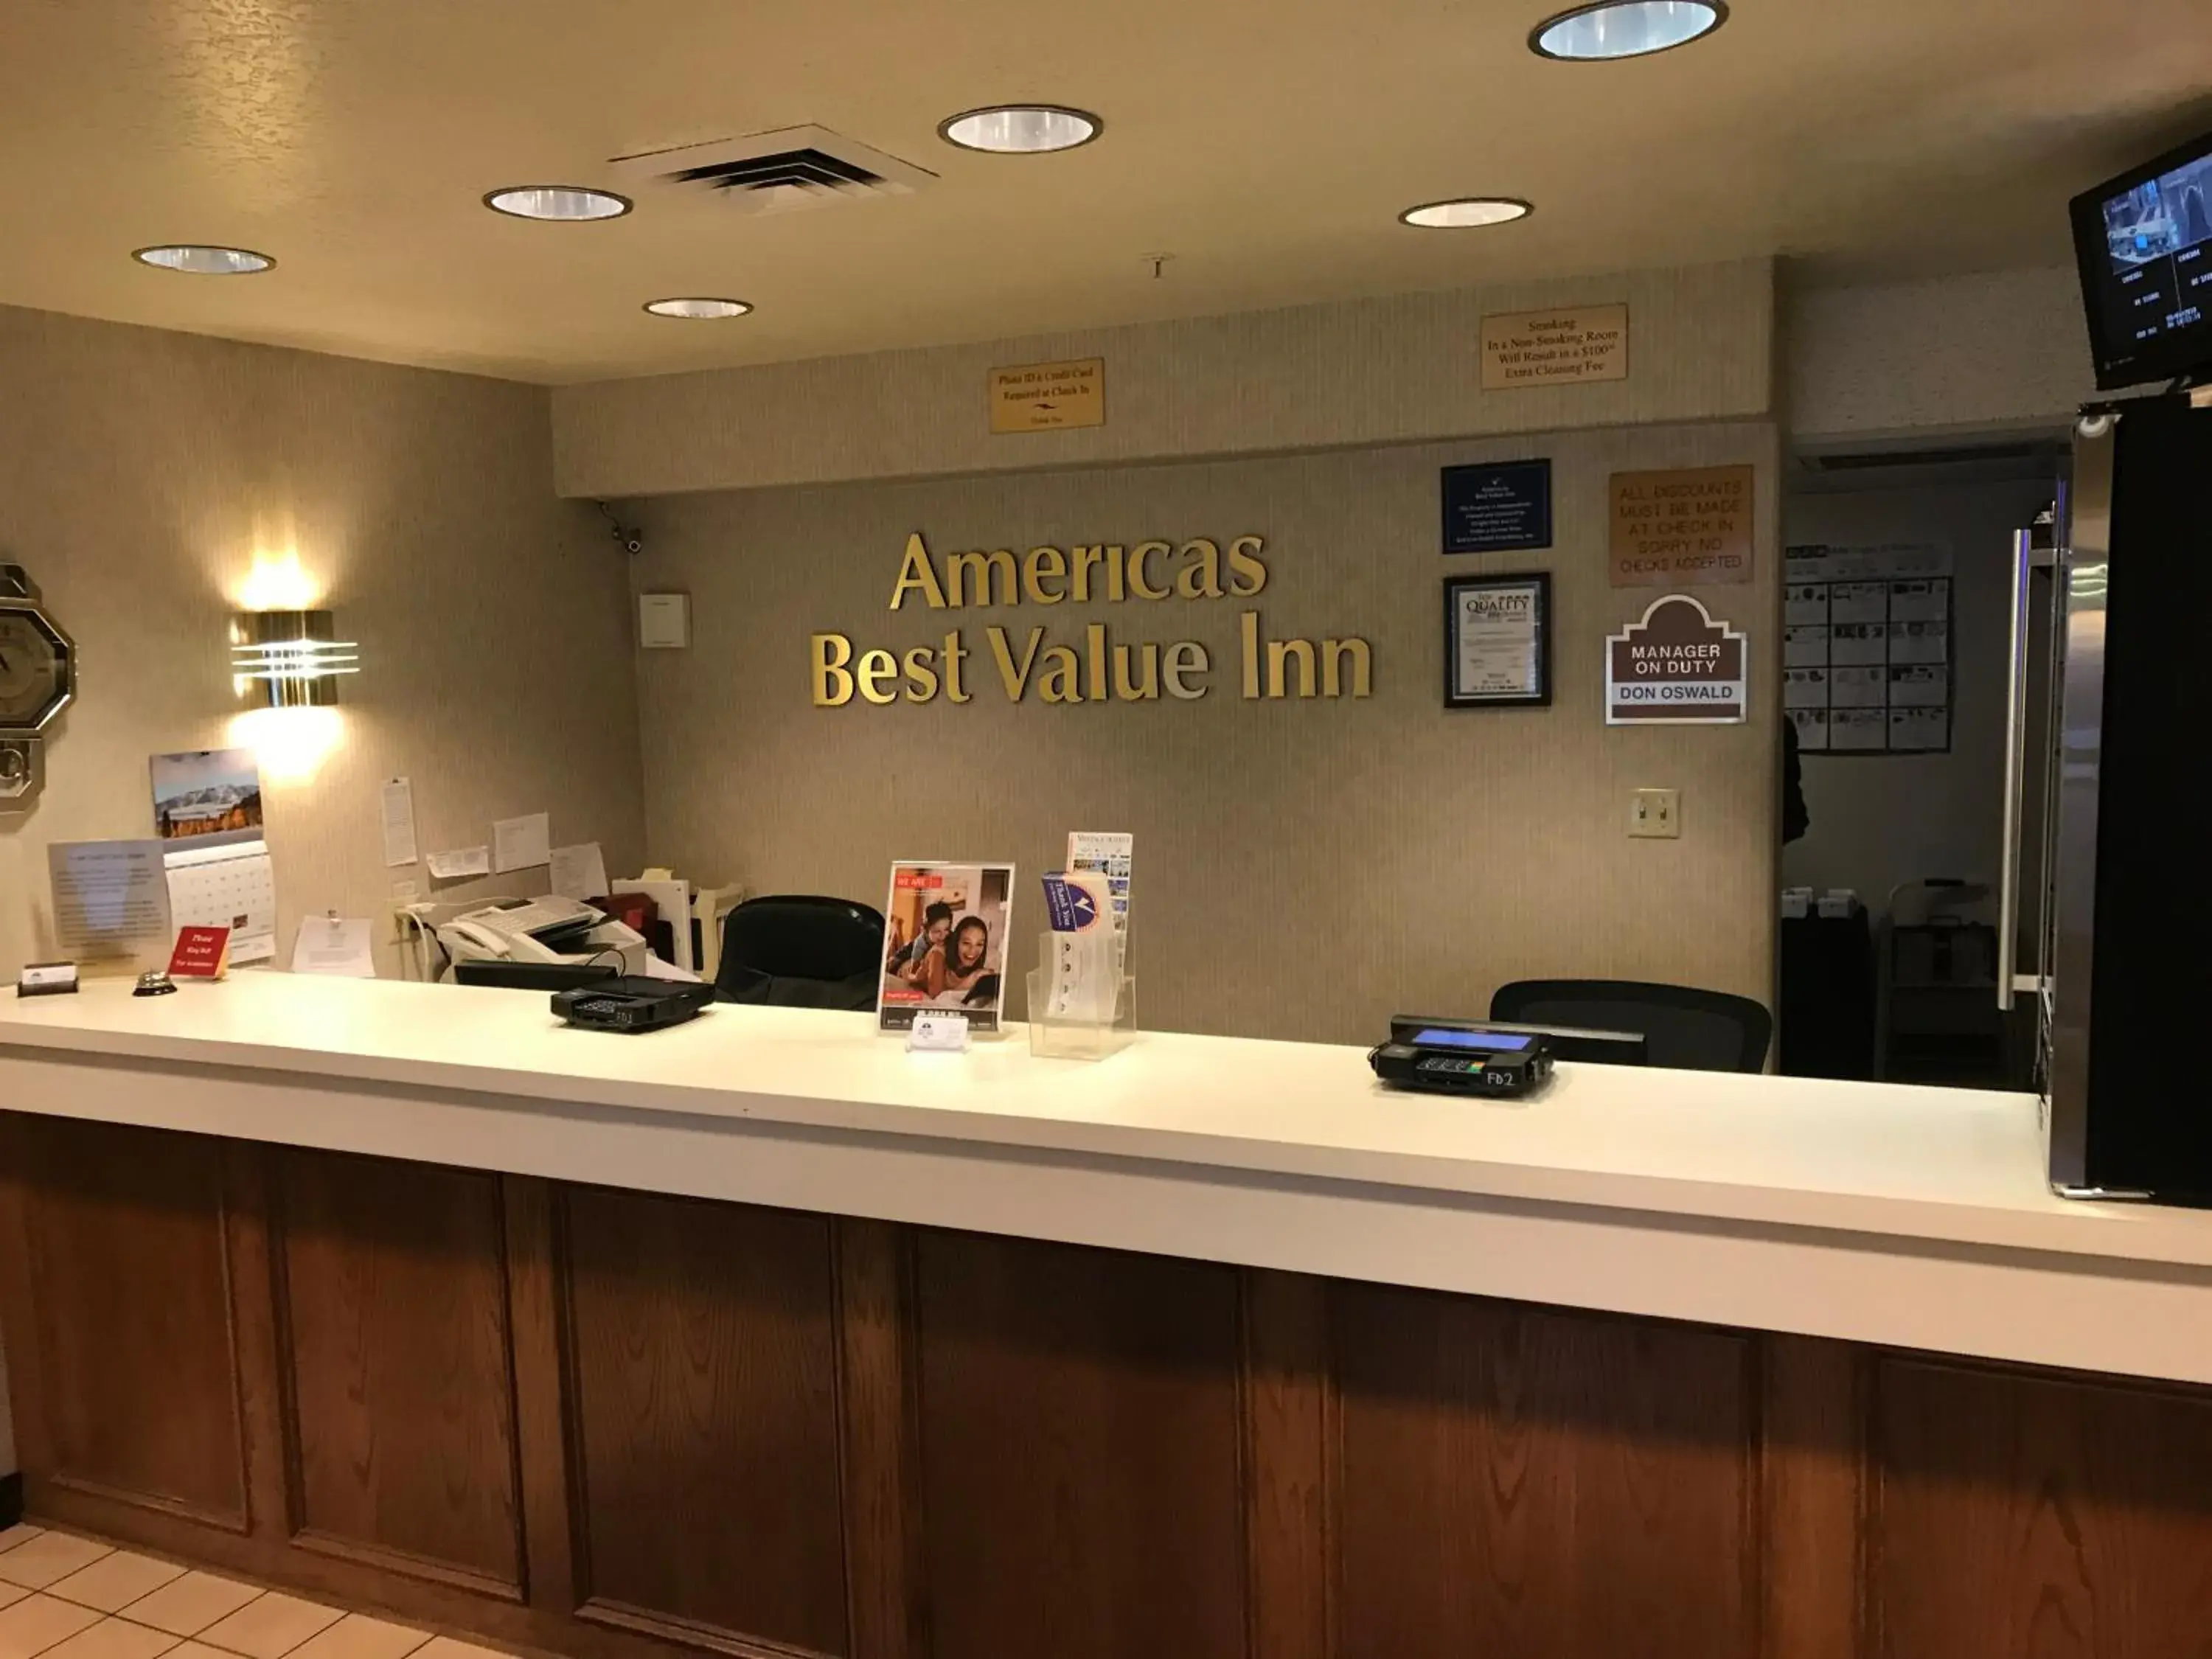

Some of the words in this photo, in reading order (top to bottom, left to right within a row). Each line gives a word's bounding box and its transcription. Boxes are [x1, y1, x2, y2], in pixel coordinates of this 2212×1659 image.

[1528, 319, 1576, 332] Smoking
[1488, 340, 1498, 350] In
[1511, 333, 1583, 349] Non-Smoking
[1586, 330, 1618, 341] Room
[1498, 352, 1520, 364] Will
[1524, 349, 1557, 362] Result
[1559, 348, 1570, 358] in
[1024, 372, 1034, 383] ID
[1505, 366, 1533, 379] Extra
[1536, 363, 1582, 376] Cleaning
[1585, 360, 1605, 372] Fee
[1051, 386, 1077, 397] Check
[1620, 486, 1646, 500] ALL
[1654, 481, 1743, 498] DISCOUNTS
[1619, 503, 1660, 518] MUST
[1669, 501, 1689, 516] BE
[1697, 498, 1741, 515] MADE
[1628, 523, 1649, 536] AT
[1657, 519, 1711, 535] CHECK
[1719, 518, 1734, 532] IN
[1638, 539, 1691, 554] SORRY
[1700, 538, 1722, 551] NO
[889, 532, 1269, 611] Americas
[1620, 558, 1669, 574] CHECKS
[1675, 554, 1742, 571] ACCEPTED
[1467, 599, 1527, 613] QUALITY
[810, 629, 973, 707] Best
[987, 624, 1210, 704] Value
[1240, 610, 1373, 701] Inn
[1631, 644, 1721, 659] MANAGER
[1635, 661, 1660, 675] ON
[1667, 660, 1717, 674] DUTY
[1620, 686, 1656, 700] DON
[1660, 686, 1733, 700] OSWALD
[1486, 1072, 1515, 1086] FD2
